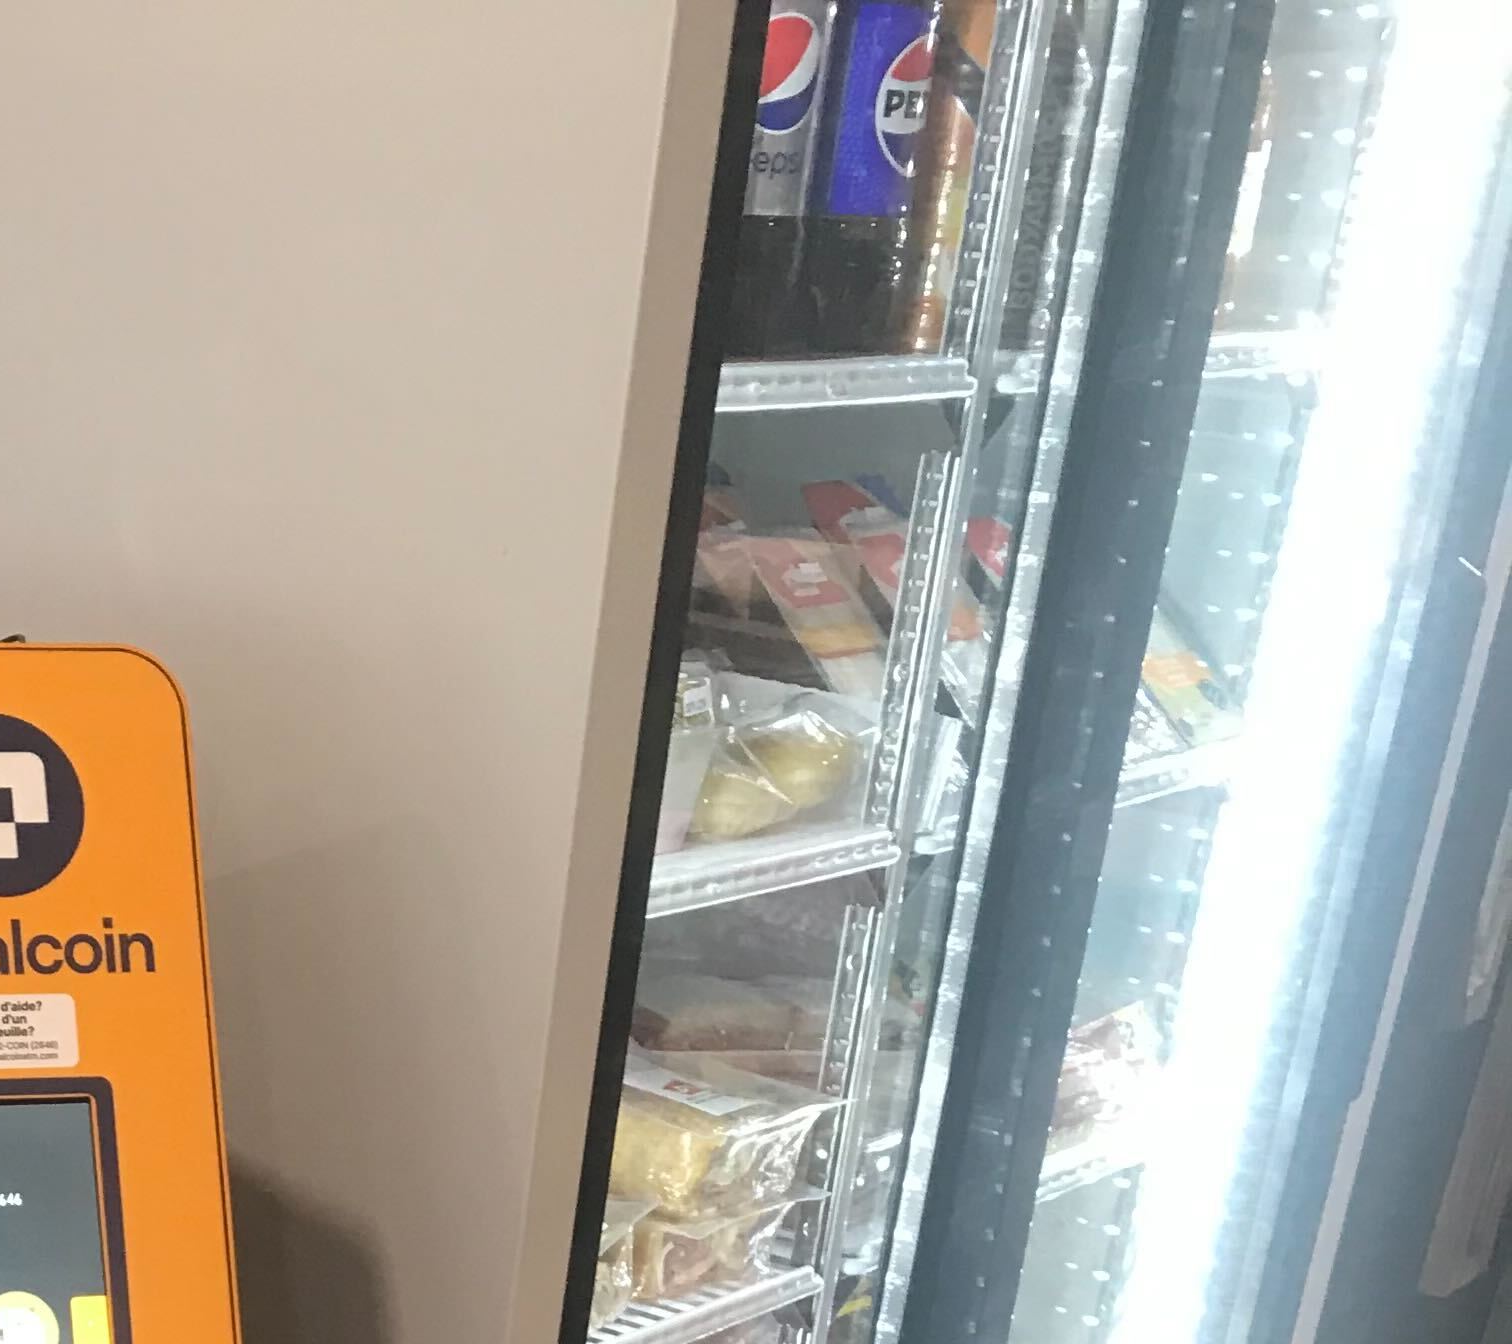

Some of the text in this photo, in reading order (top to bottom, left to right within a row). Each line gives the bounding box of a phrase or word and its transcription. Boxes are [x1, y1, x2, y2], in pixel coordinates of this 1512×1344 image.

[883, 89, 926, 119] PE
[0, 1000, 43, 1012] d'aide?
[1, 1013, 28, 1025] d'un
